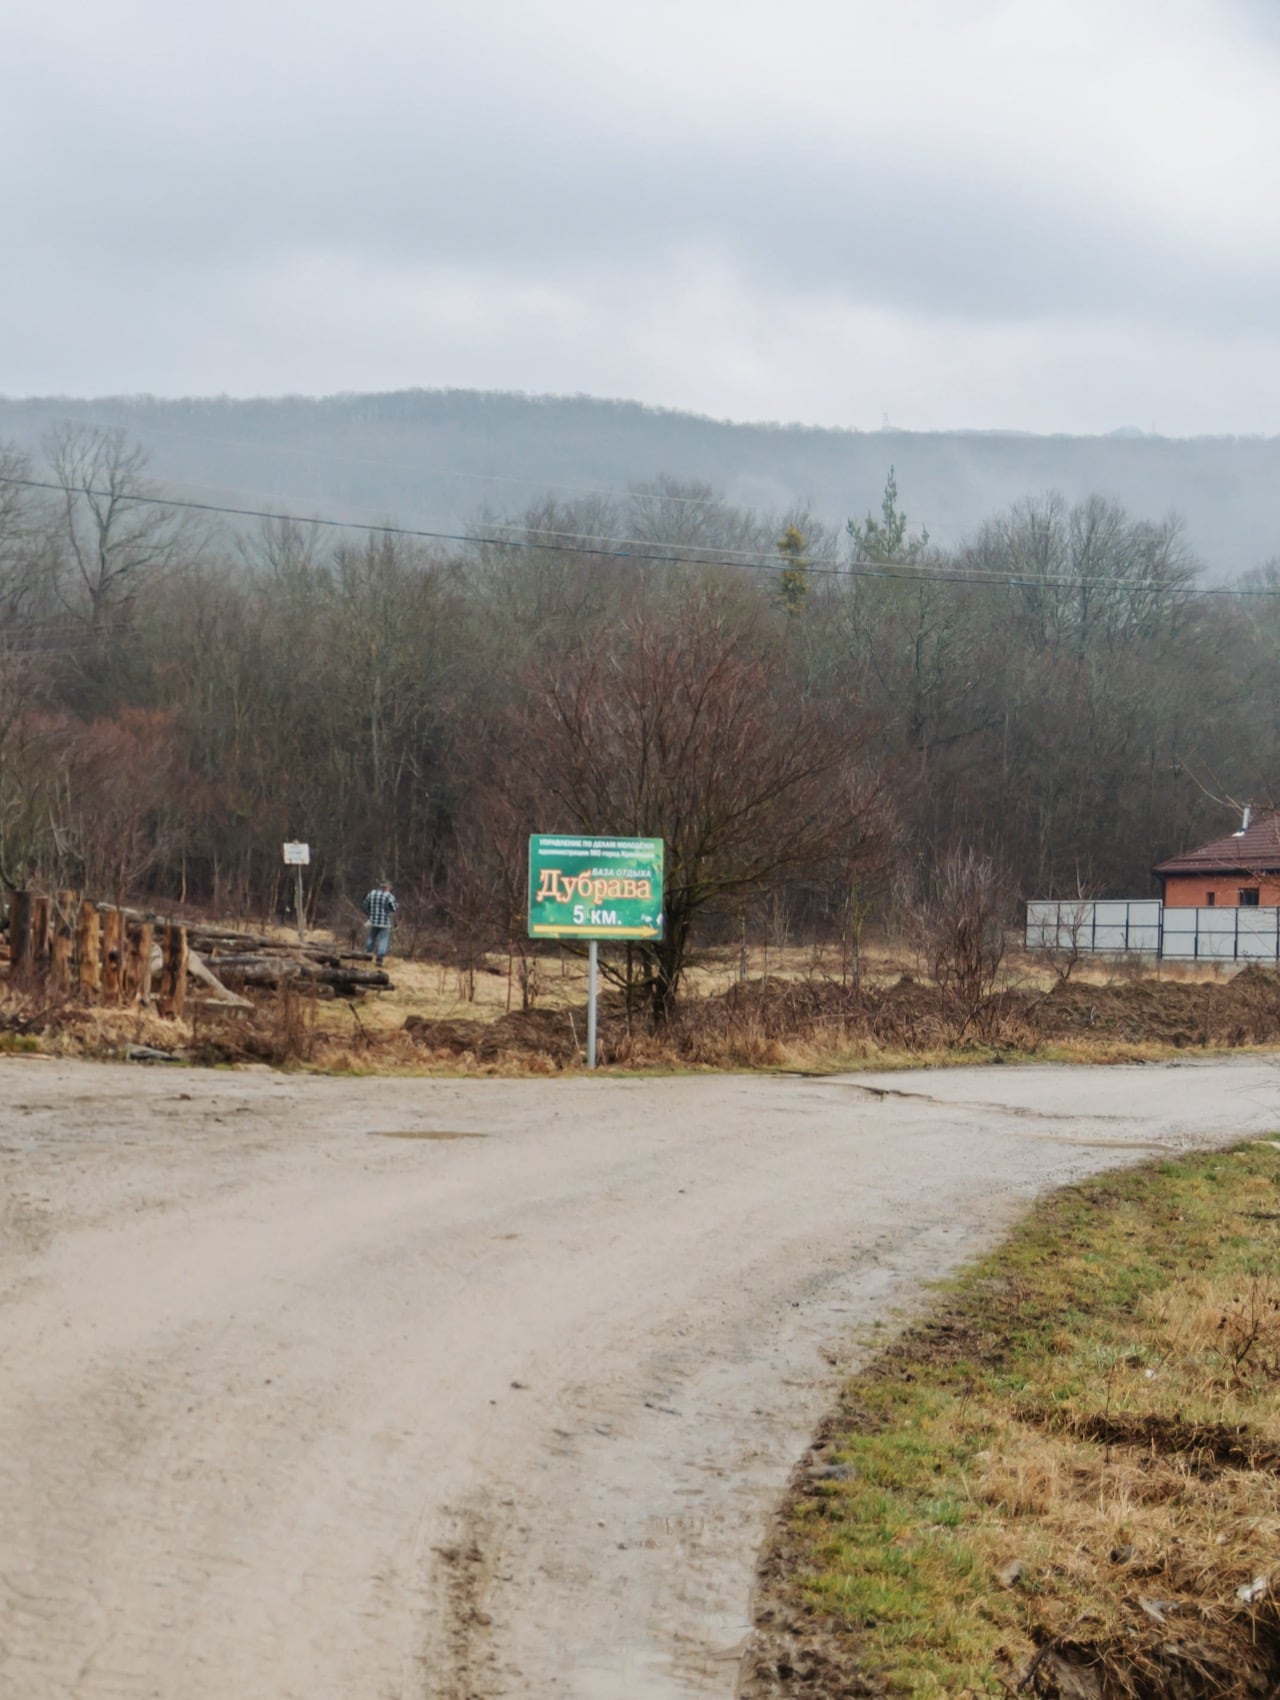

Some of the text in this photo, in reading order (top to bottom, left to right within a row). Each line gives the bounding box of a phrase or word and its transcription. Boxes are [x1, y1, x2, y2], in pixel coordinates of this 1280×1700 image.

[591, 867, 652, 878] БАЗА ОТДЫХА
[536, 868, 652, 905] Дубрава
[573, 905, 585, 924] 5
